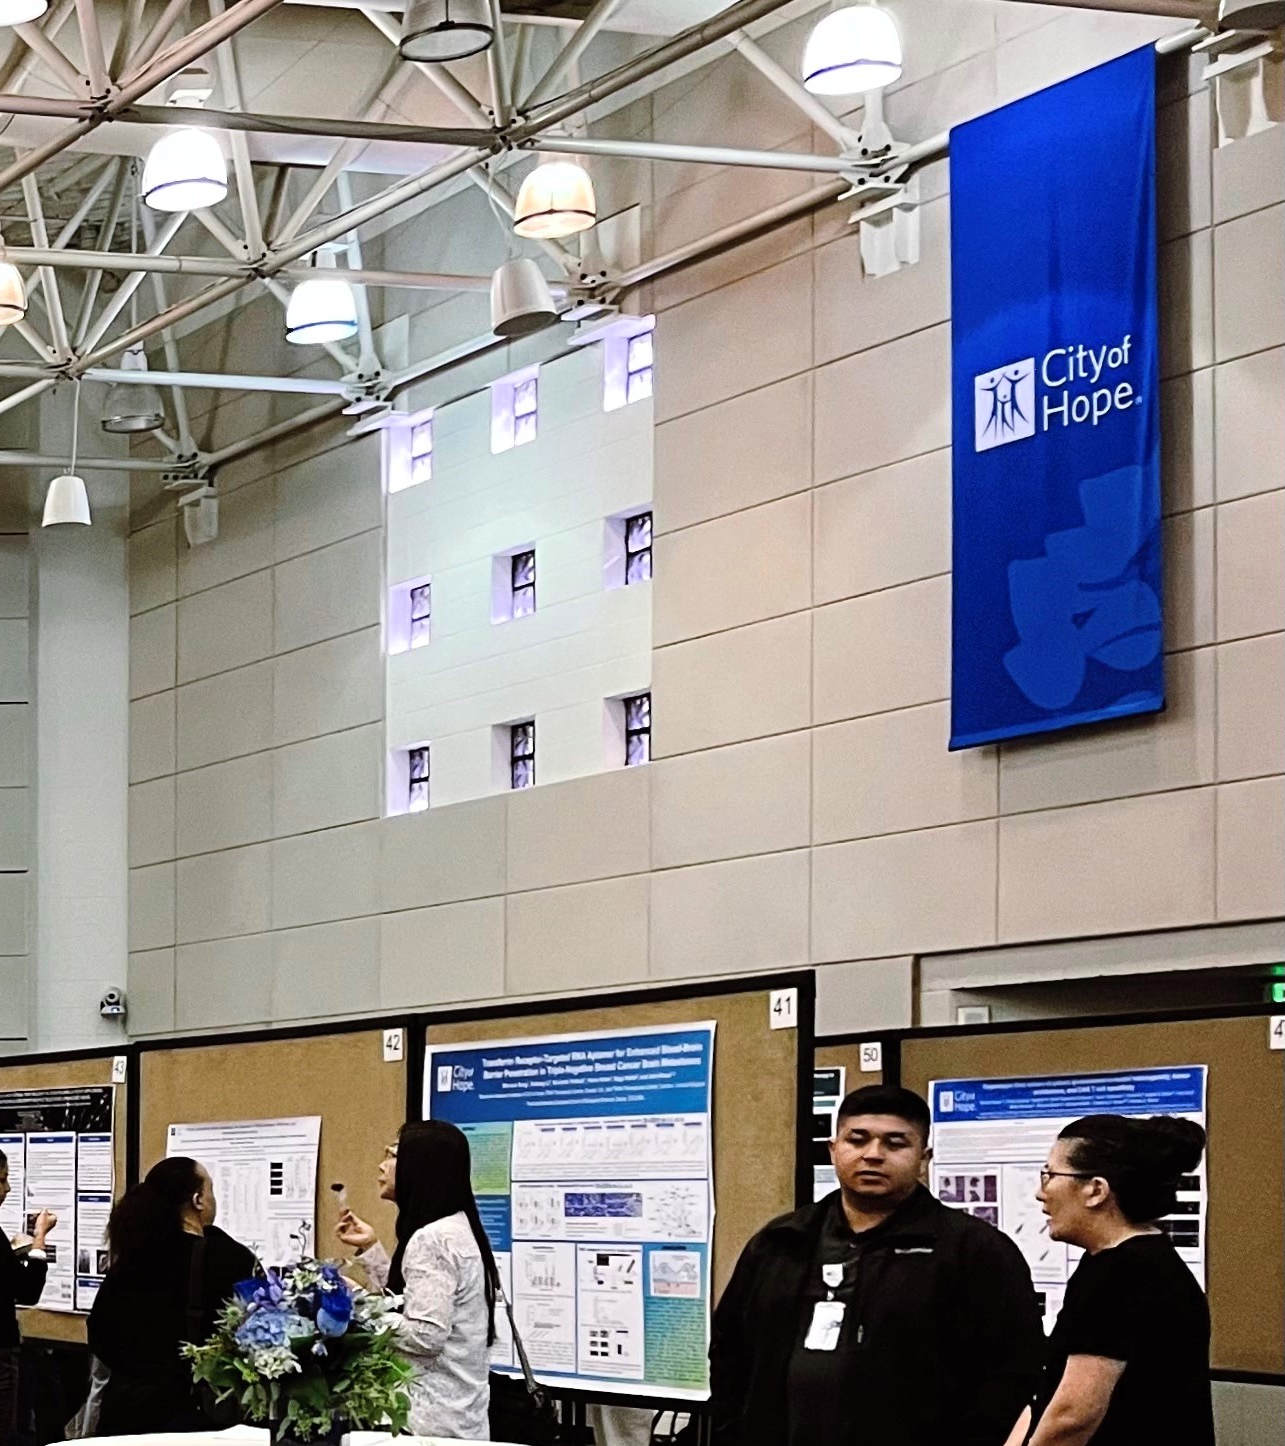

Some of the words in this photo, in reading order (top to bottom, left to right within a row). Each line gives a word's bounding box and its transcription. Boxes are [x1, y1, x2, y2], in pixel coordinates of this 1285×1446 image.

[1041, 344, 1107, 388] City
[1042, 381, 1134, 431] Hope
[773, 995, 791, 1016] 41
[386, 1034, 401, 1051] 42
[863, 1047, 879, 1062] 50
